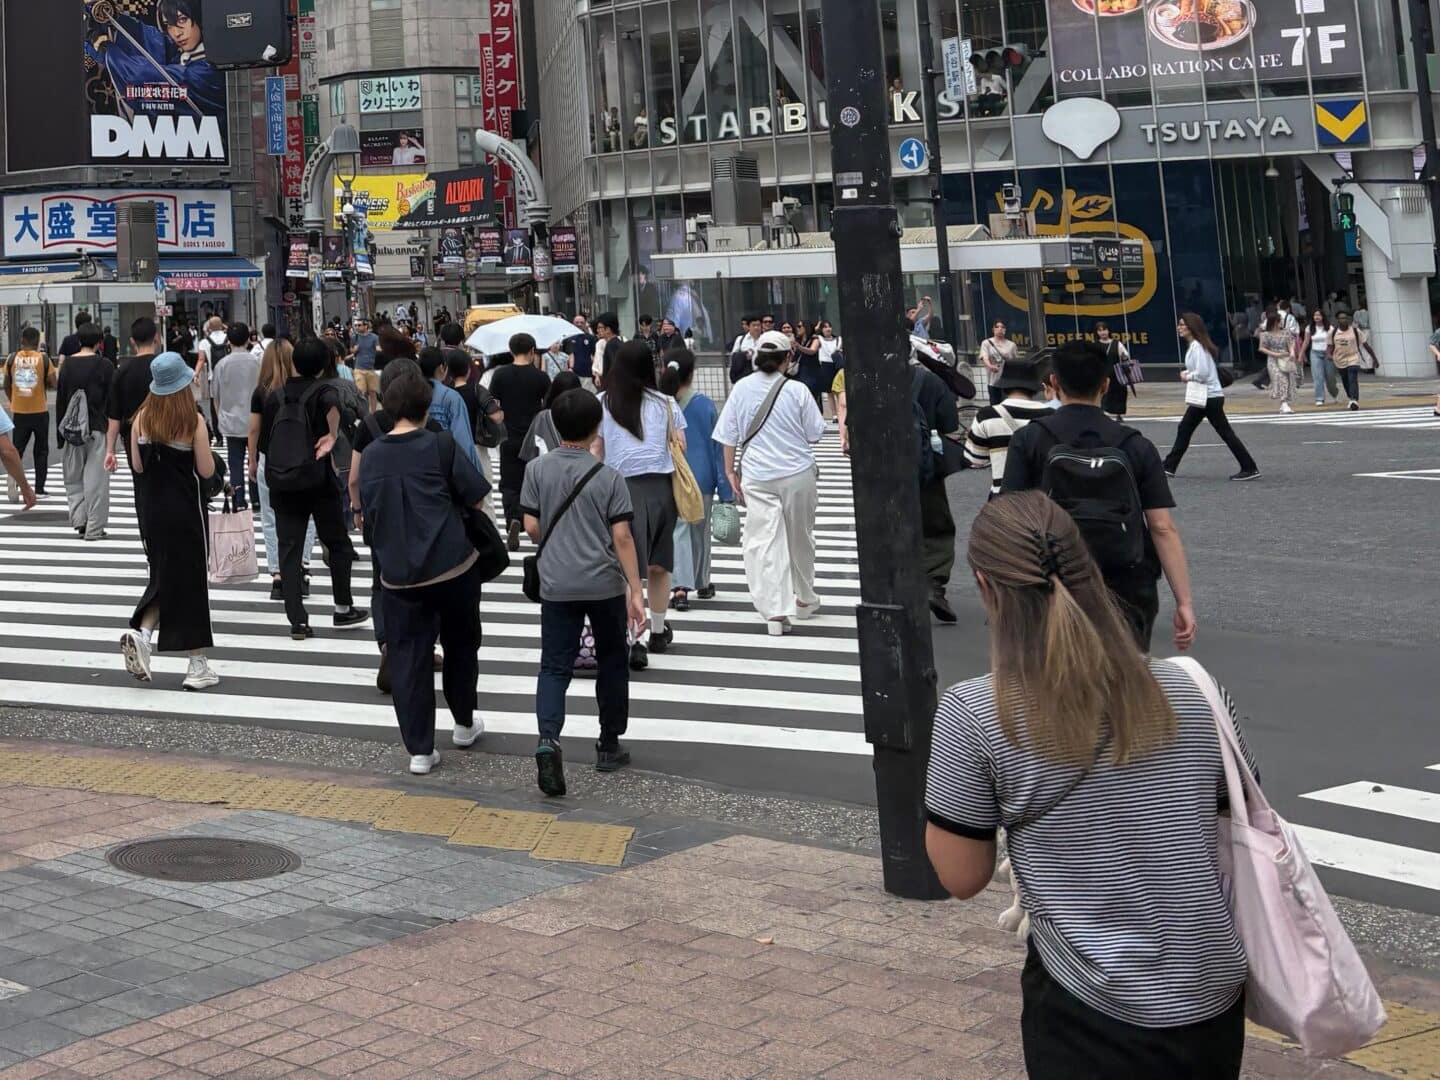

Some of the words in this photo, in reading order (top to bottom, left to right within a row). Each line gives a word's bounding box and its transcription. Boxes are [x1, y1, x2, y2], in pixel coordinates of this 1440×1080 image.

[493, 1, 516, 95] カラオケ
[1280, 24, 1347, 67] 7F
[1060, 56, 1224, 84] COLLABORATION
[1228, 52, 1283, 72] CAFE
[375, 79, 420, 94] れいわ
[361, 95, 421, 111] クリニック
[660, 89, 961, 145] STARBKS
[90, 114, 225, 158] DMM
[1140, 115, 1294, 144] TSUTAYA
[352, 197, 389, 210] OCKERS
[445, 177, 485, 205] ALVARK
[1011, 333, 1030, 345] Mr
[1111, 332, 1148, 345] PPLE
